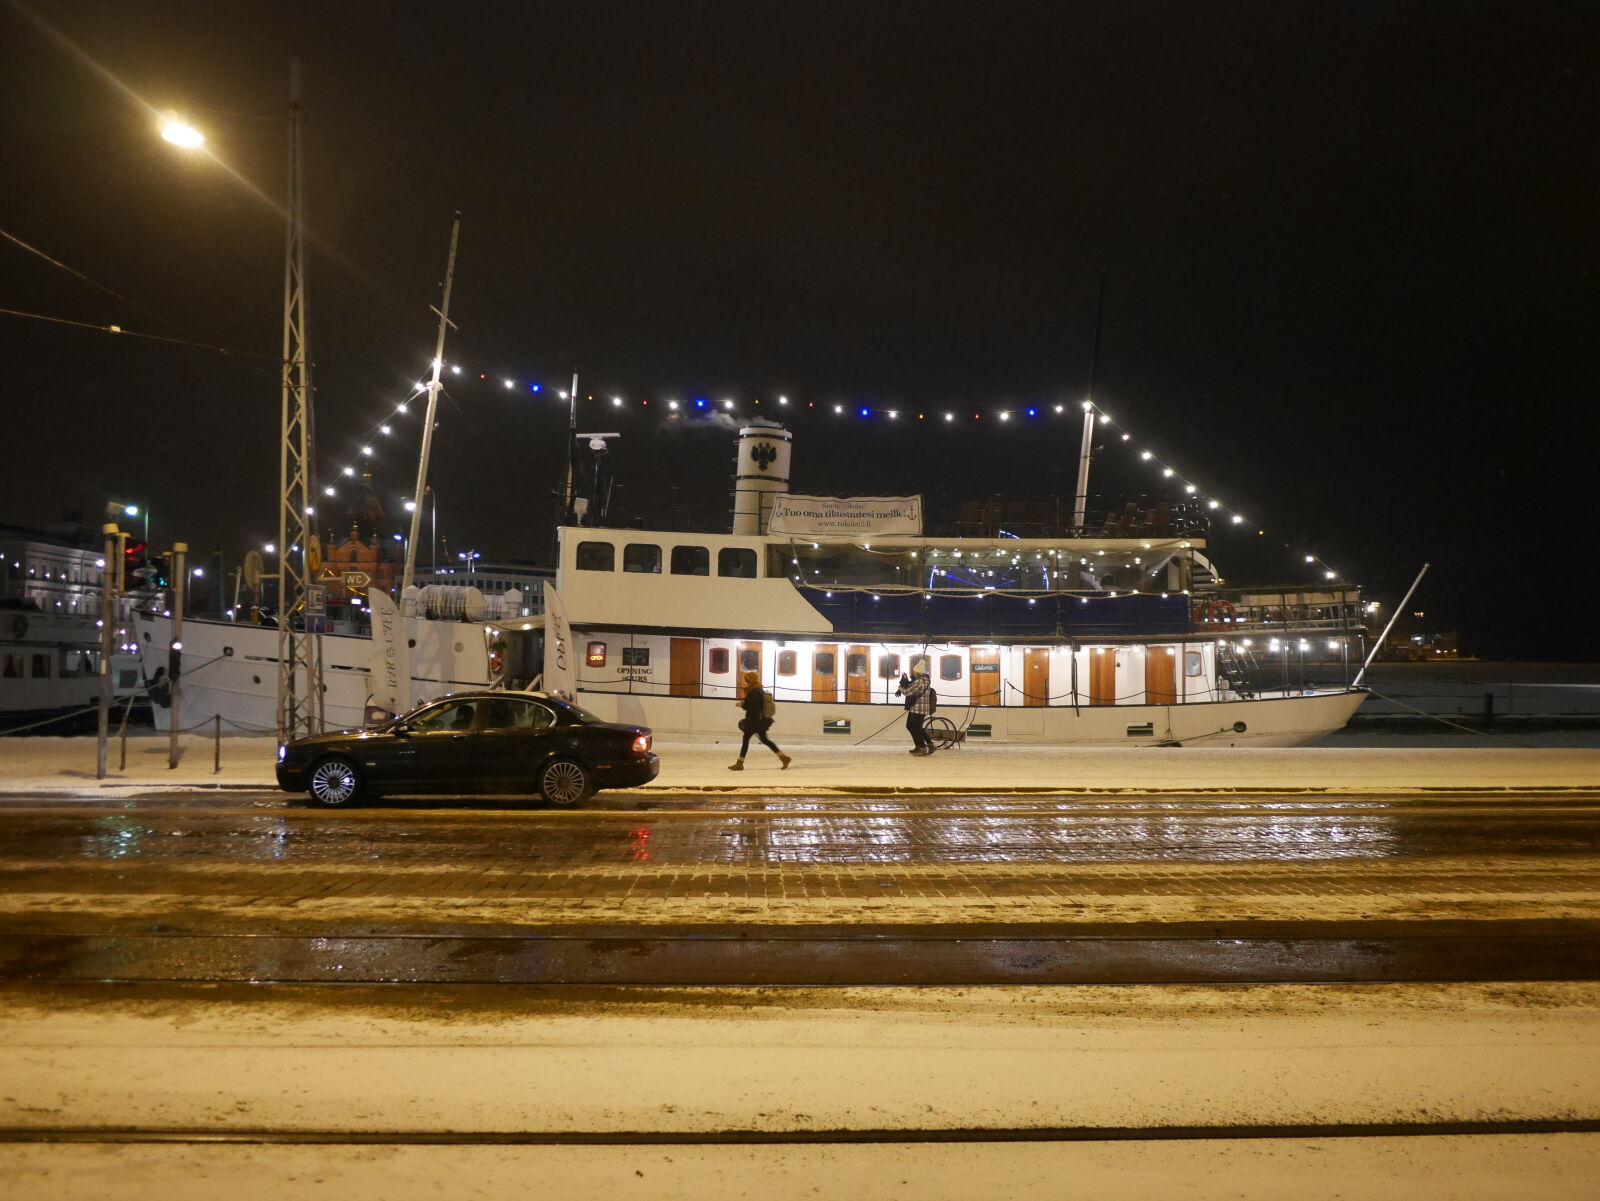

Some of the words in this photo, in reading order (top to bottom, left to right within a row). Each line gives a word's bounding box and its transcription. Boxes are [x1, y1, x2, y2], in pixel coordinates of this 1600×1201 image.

[783, 507, 802, 517] Tuo
[803, 510, 824, 519] oma
[347, 575, 362, 584] WC
[616, 667, 653, 675] OPENING
